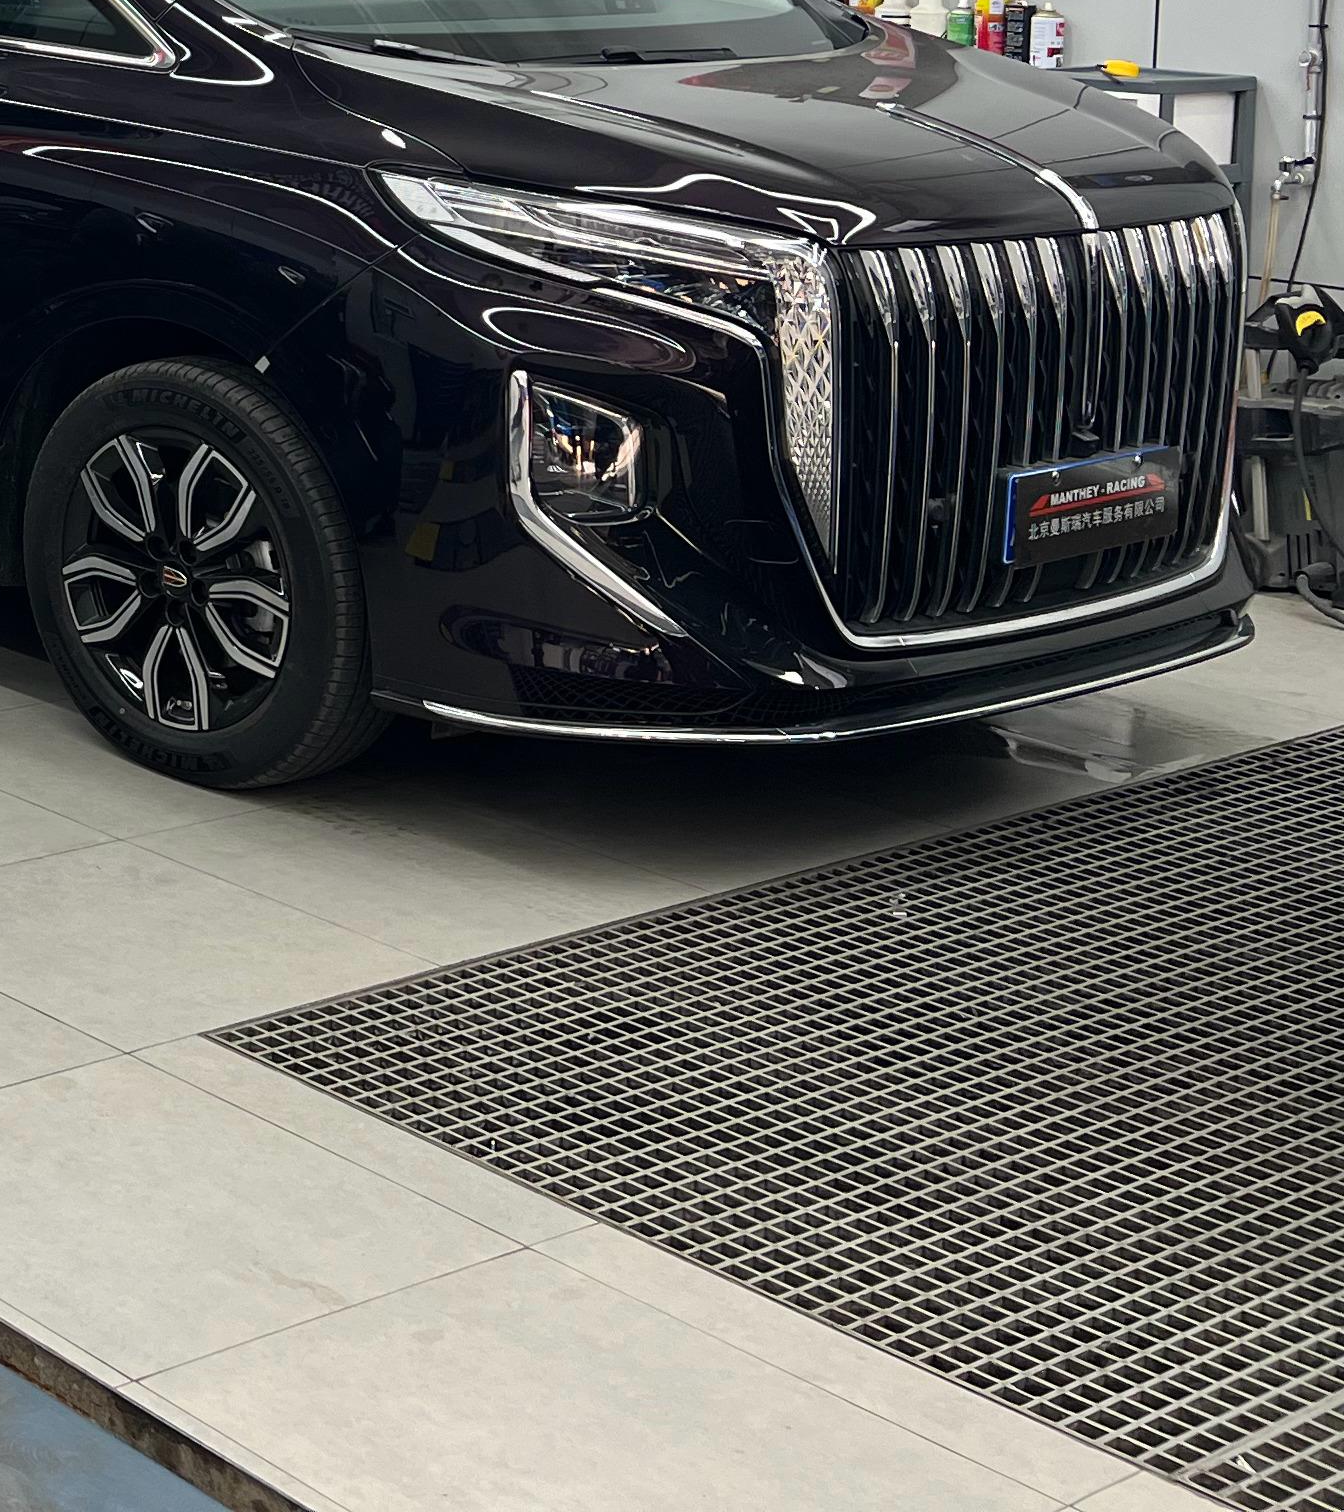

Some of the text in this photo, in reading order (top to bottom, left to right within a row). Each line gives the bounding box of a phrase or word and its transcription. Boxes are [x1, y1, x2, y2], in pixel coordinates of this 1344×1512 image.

[1049, 486, 1101, 507] MANTHEY
[1106, 475, 1146, 496] RACING
[1027, 496, 1166, 541] 北京曼斯瑞汽车服务有限公司
